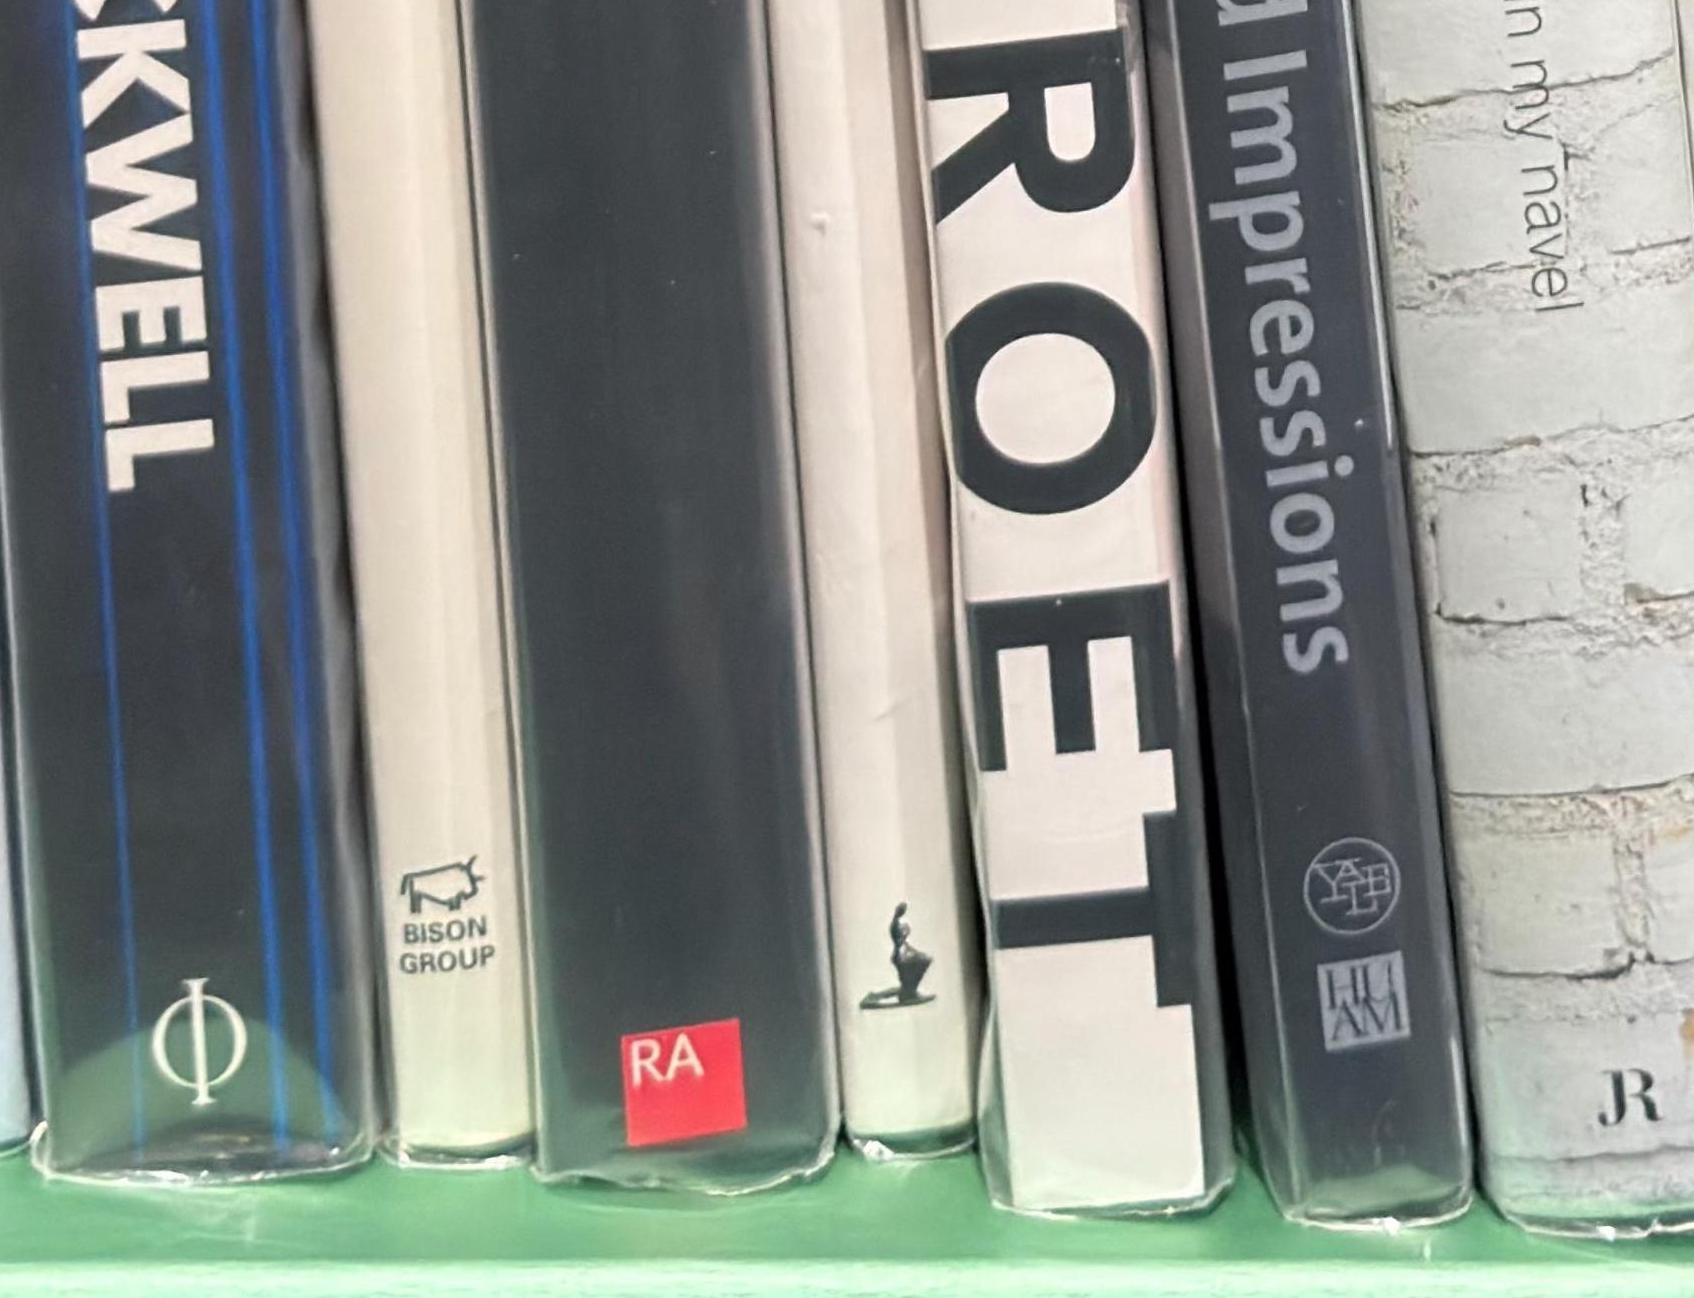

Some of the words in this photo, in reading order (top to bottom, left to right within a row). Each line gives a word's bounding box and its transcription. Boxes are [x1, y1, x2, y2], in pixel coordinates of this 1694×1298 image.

[1504, 59, 1552, 140] my
[1521, 165, 1585, 312] navel
[1209, 49, 1355, 674] Impressions
[925, 26, 1191, 1007] ROET
[400, 944, 495, 974] GROUP
[404, 915, 487, 944] BISON
[630, 1033, 705, 1088] RA
